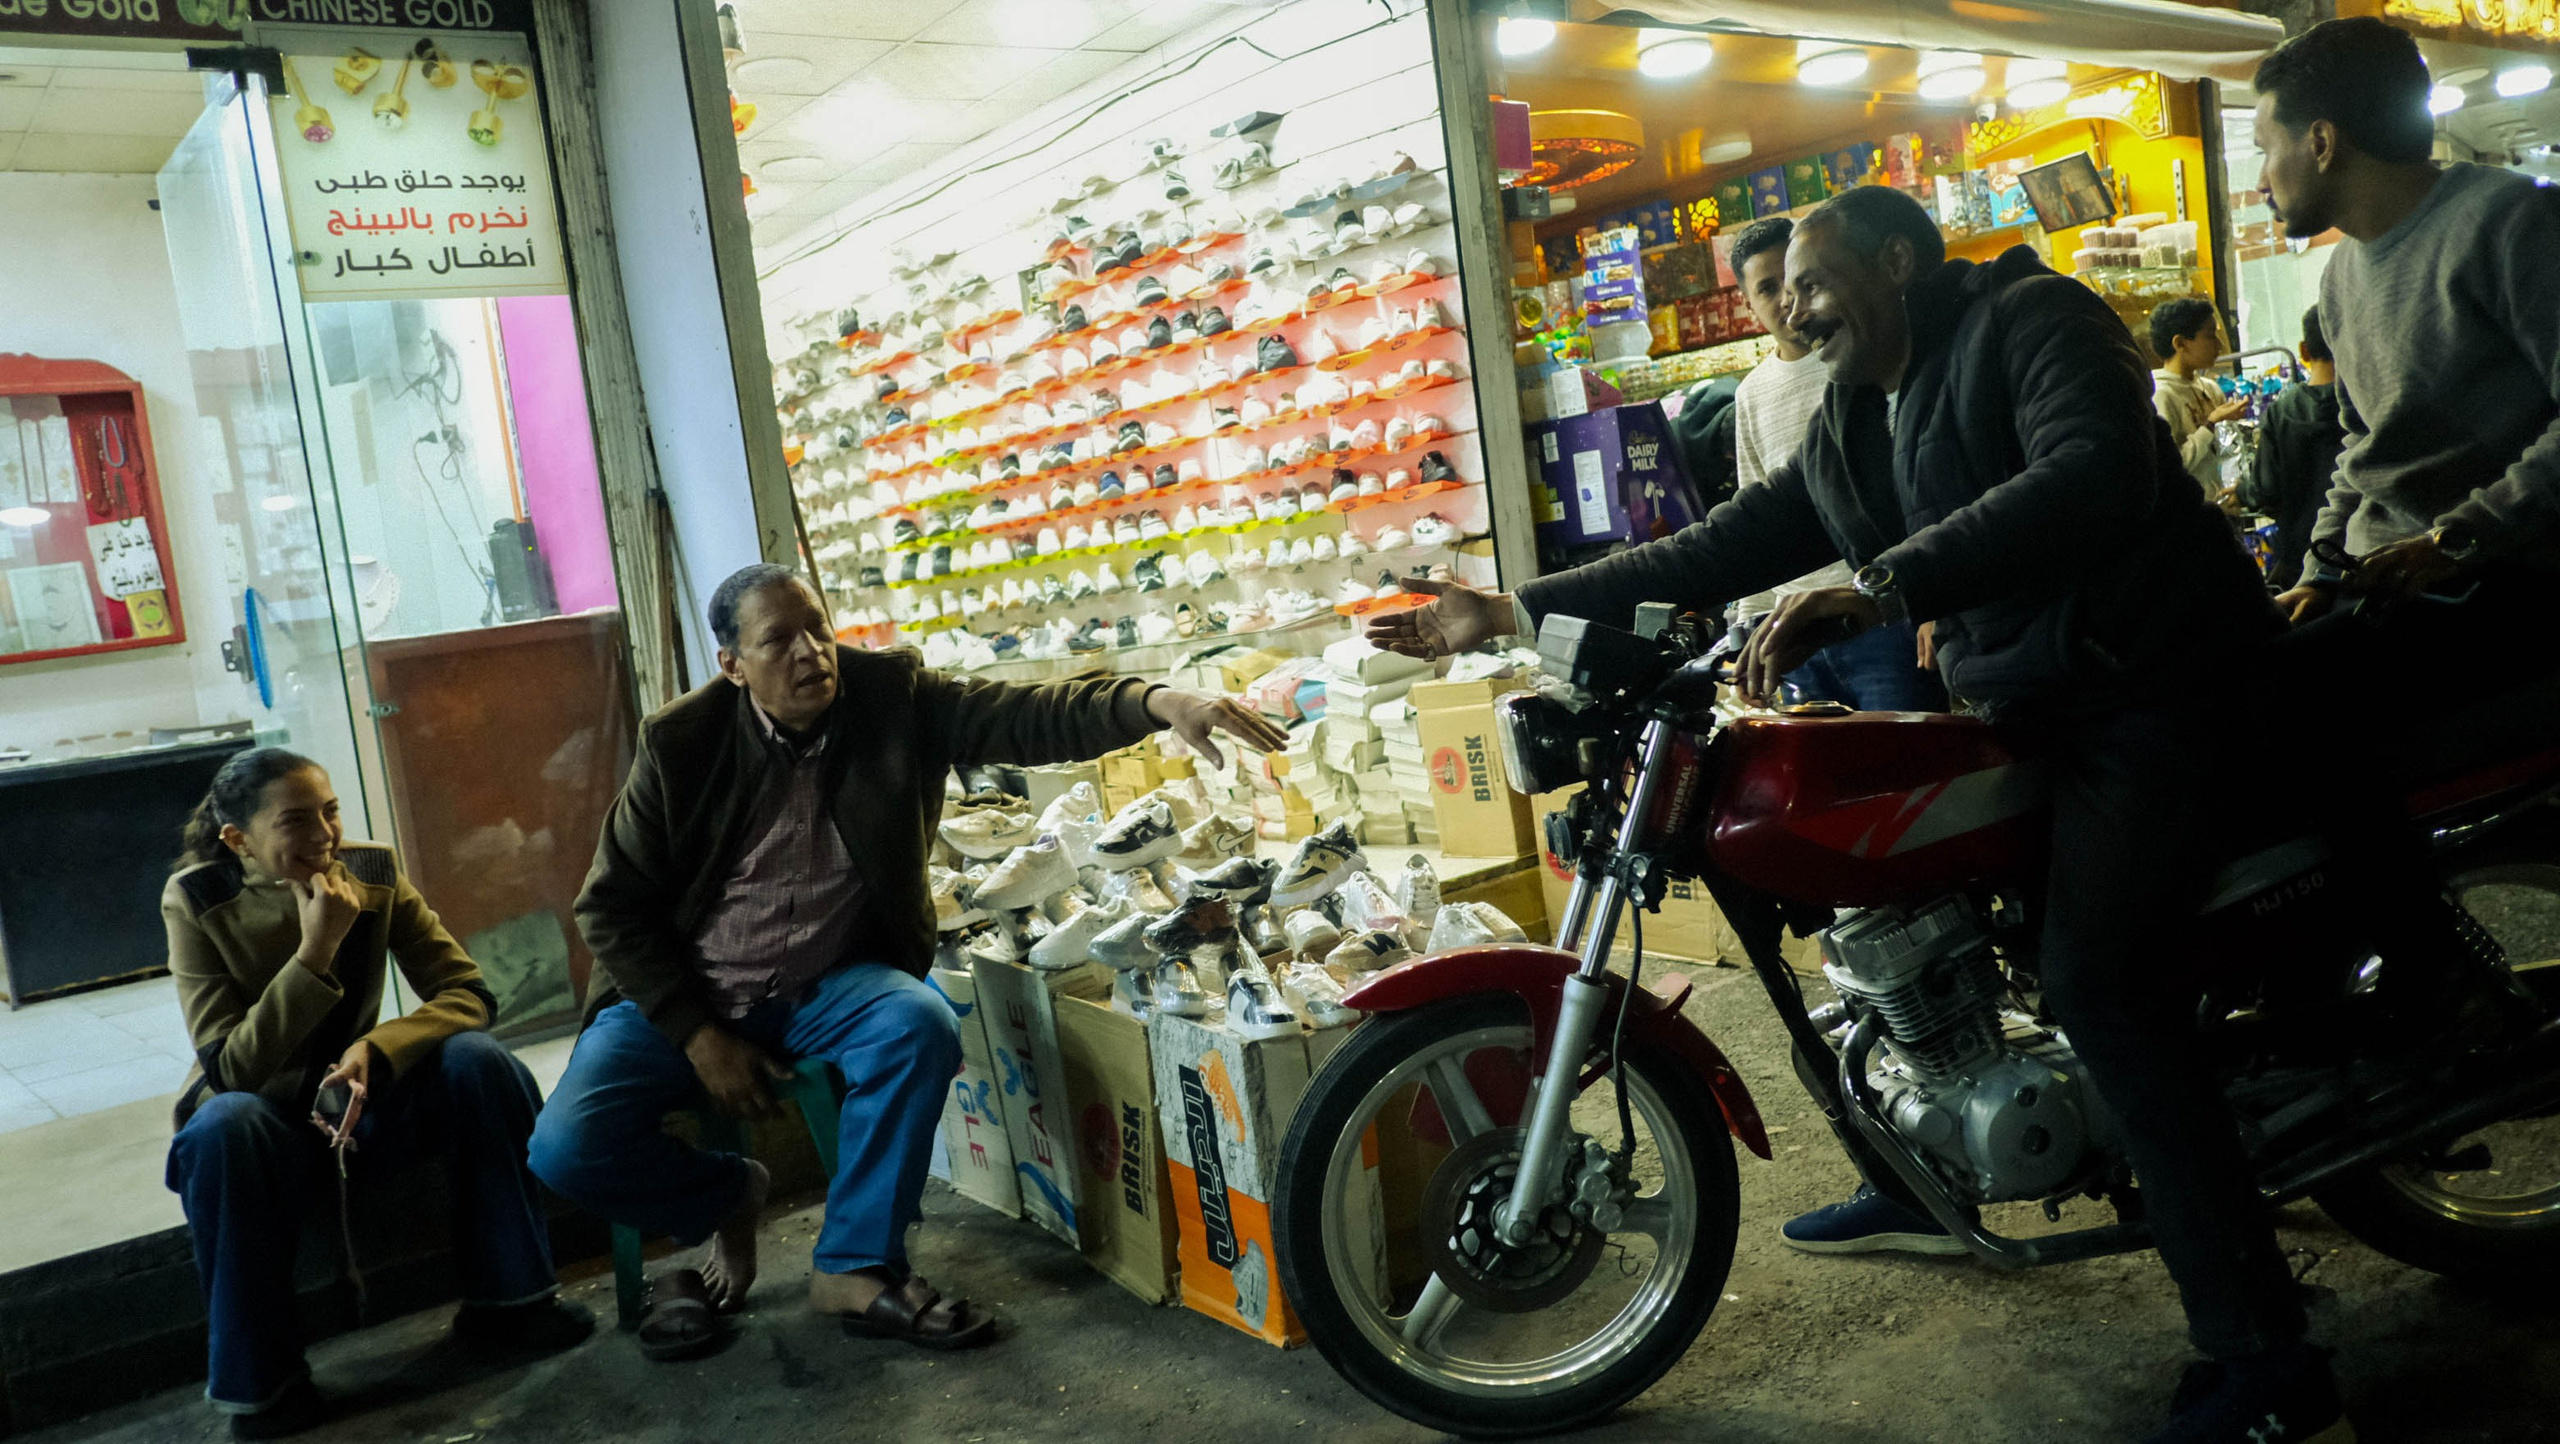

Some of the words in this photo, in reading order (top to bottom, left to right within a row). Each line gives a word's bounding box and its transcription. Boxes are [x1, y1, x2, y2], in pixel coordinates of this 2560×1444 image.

[258, 0, 397, 24] CHINESE
[404, 0, 494, 28] GOLD
[394, 169, 453, 193] حلق
[460, 175, 527, 193] يوجد
[327, 206, 434, 236] بالبينج
[448, 205, 529, 234] نخرم
[334, 247, 413, 278] كبار
[428, 238, 536, 275] أطفال
[1627, 442, 1659, 459] DAIRY
[1632, 456, 1658, 472] MILK
[1464, 734, 1492, 801] BRISK
[1665, 764, 1693, 835] UNIVERSAL
[1006, 999, 1054, 1168] EAGLE
[956, 1063, 989, 1170] GLE
[1121, 1100, 1144, 1216] BRISK
